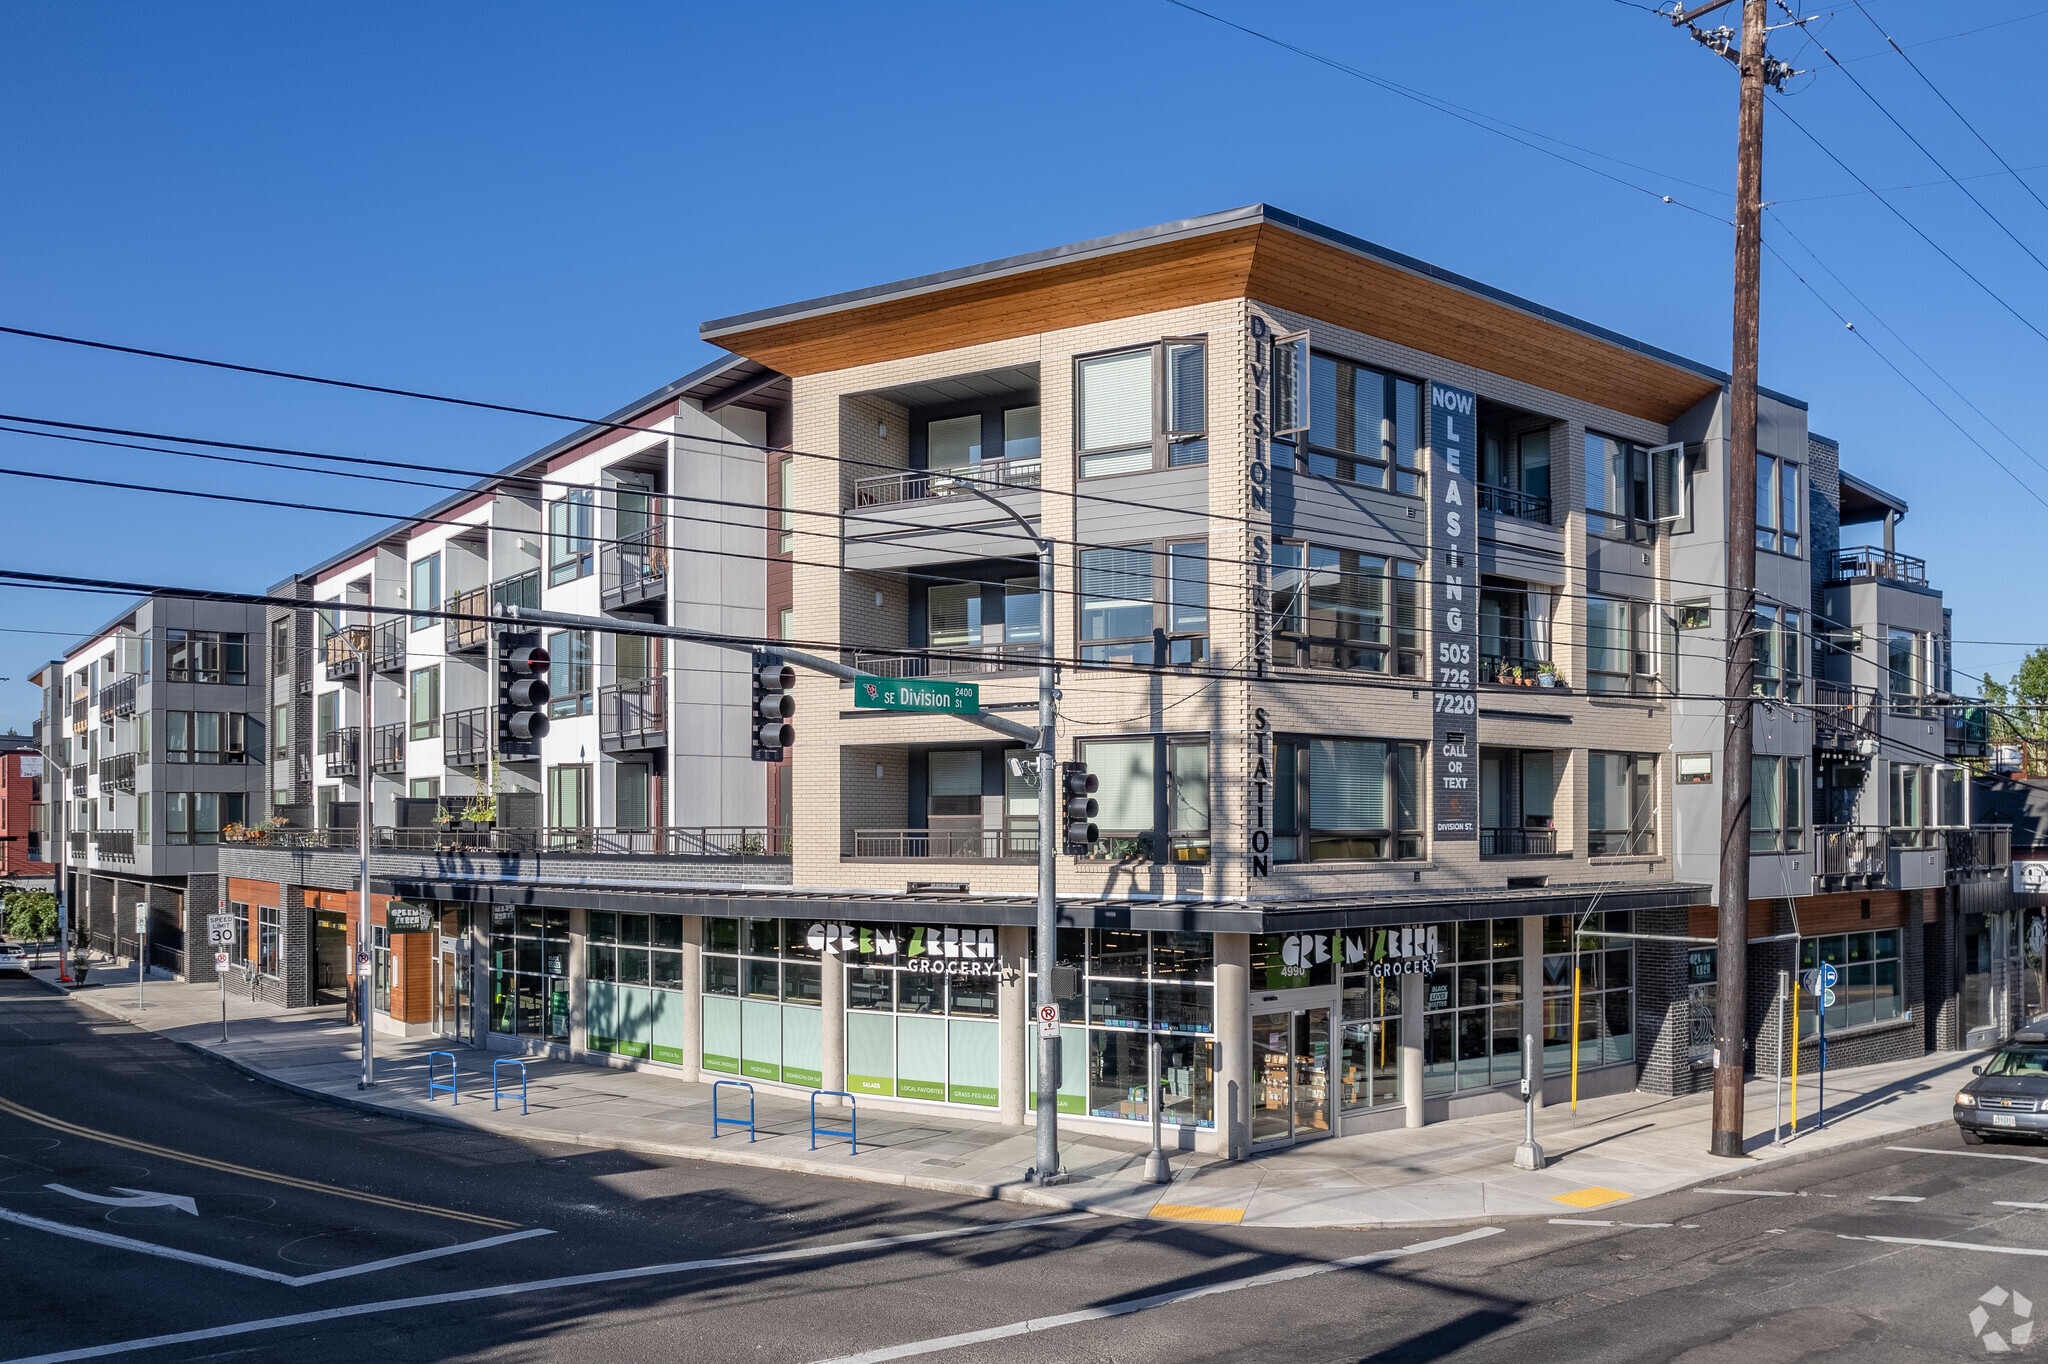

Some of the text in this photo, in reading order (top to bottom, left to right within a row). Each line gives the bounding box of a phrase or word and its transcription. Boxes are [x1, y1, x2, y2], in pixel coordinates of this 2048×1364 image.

[1432, 387, 1473, 415] NOW
[1250, 315, 1267, 509] DIVISION
[1445, 415, 1463, 632] LEASING
[1439, 643, 1470, 664] 503
[1440, 668, 1470, 690] 726
[884, 687, 963, 709] SE Division St
[954, 687, 973, 698] 2400
[1435, 693, 1475, 714] 7220
[1443, 745, 1468, 757] CALL
[1448, 761, 1463, 773] OR
[1443, 777, 1468, 789] TEXT
[1251, 707, 1269, 877] STATION
[1437, 822, 1474, 831] DIVISION ST.
[210, 916, 233, 924] SPEED
[212, 930, 232, 941] 30
[806, 923, 996, 958] GREEN ZEBRA
[1282, 925, 1438, 969] GREEN ZEBRA
[908, 959, 995, 977] GROCERY
[1280, 965, 1305, 978] 4990
[1373, 959, 1438, 978] GROCERY
[750, 1065, 772, 1074] VEGETARIAN
[786, 1072, 808, 1081] KOMBUCHA
[862, 1081, 881, 1089] SALADS
[917, 1086, 944, 1095] FAVORITES
[953, 1090, 997, 1100] GRASS-FED MEAT
